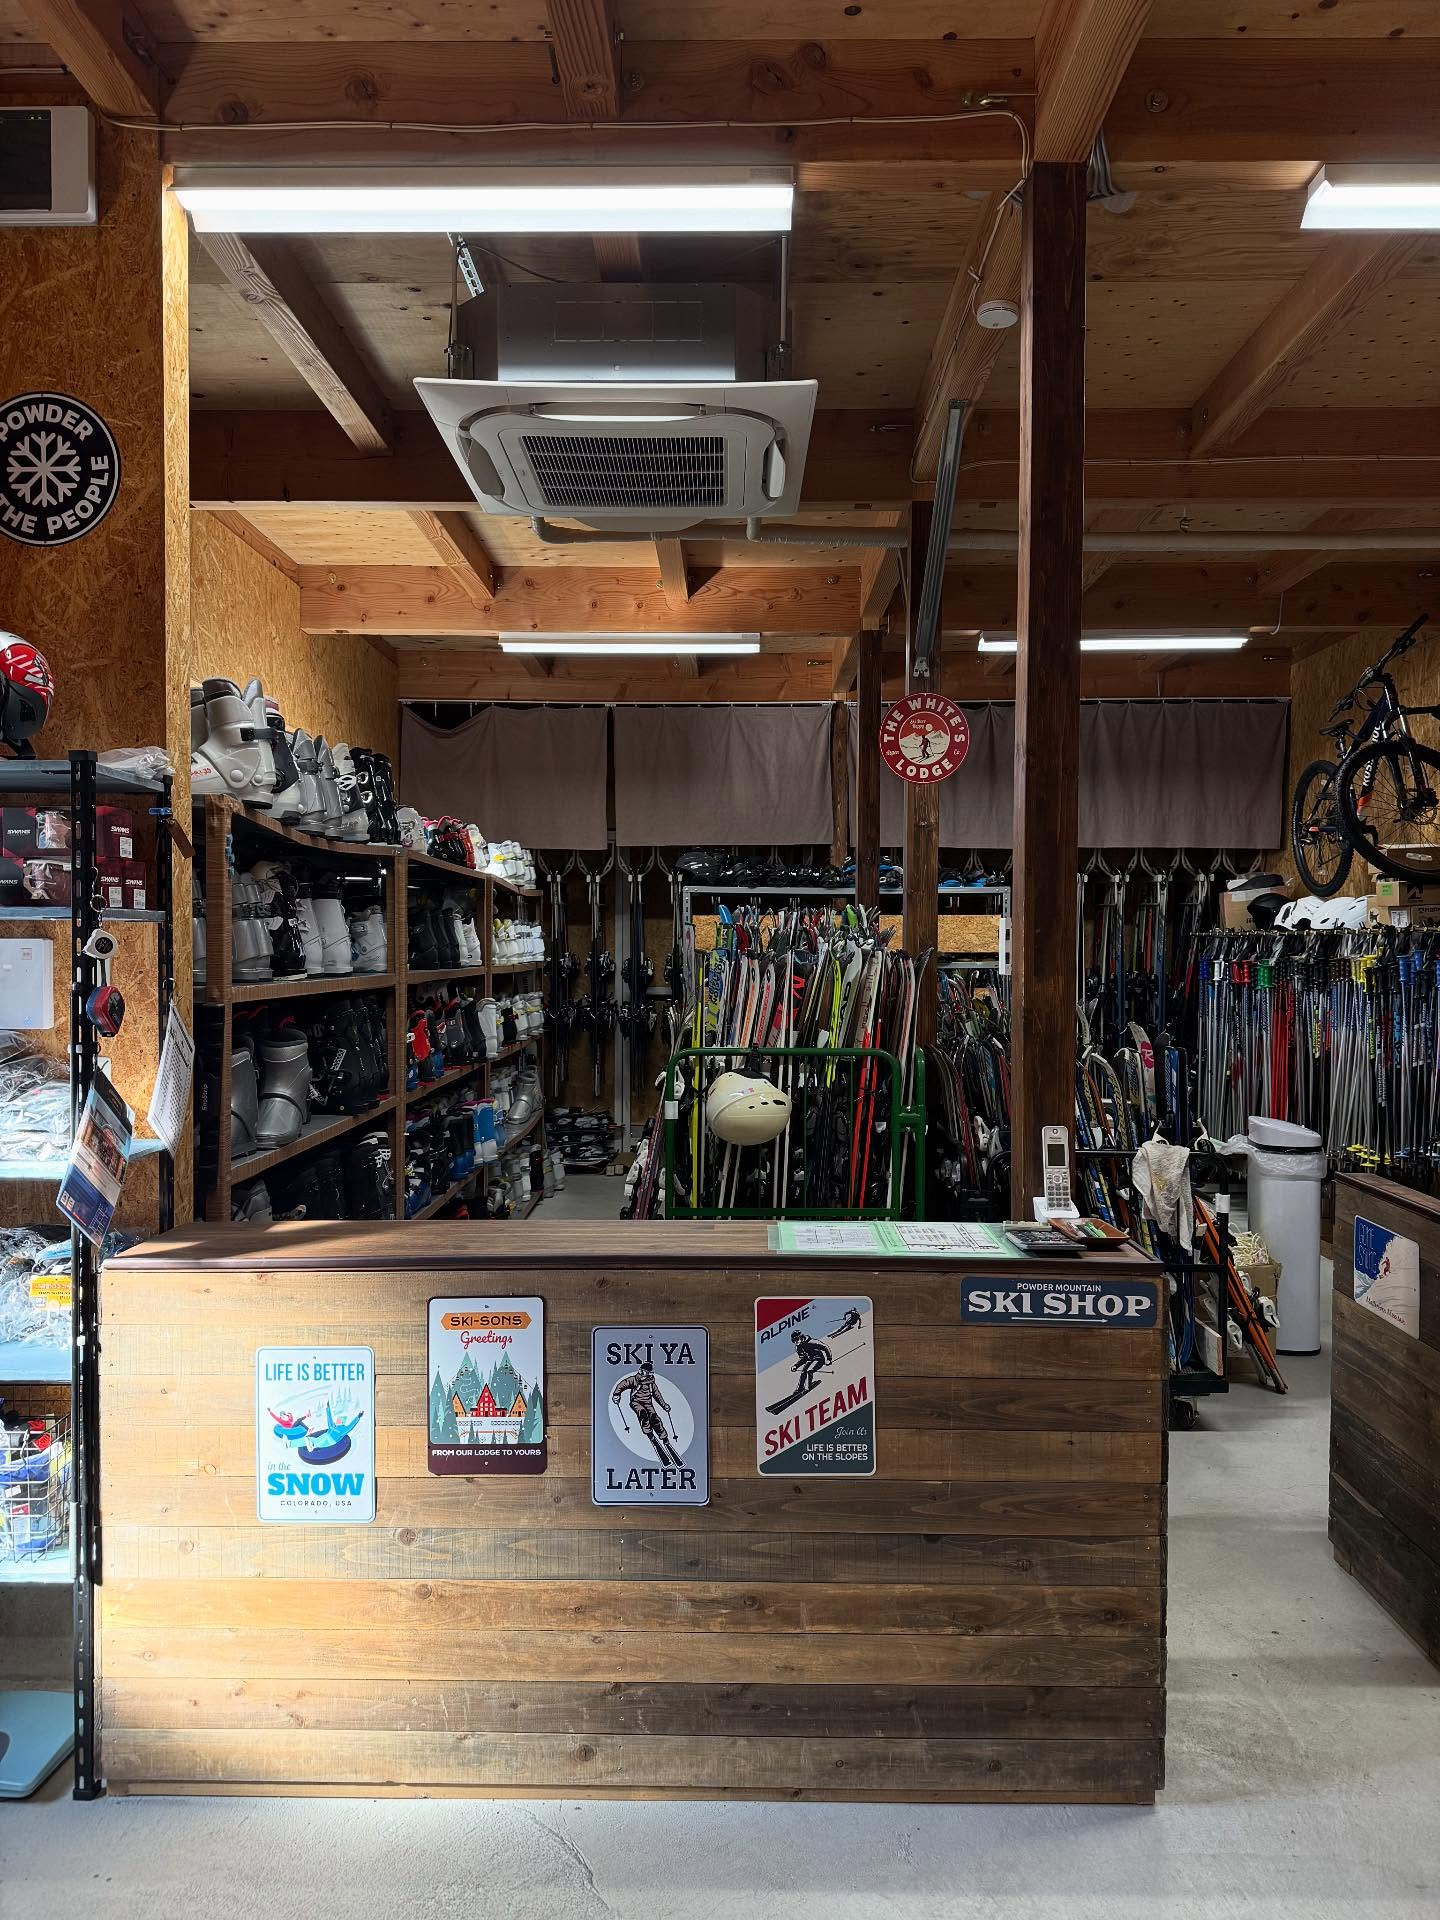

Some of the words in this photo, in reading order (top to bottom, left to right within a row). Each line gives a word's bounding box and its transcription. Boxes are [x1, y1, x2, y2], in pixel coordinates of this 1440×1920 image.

[0, 404, 93, 442] POWDER
[47, 455, 109, 534] PEOPLE
[883, 709, 904, 743] THE
[907, 697, 966, 743] WHITE'S
[895, 758, 953, 779] LODGE
[110, 825, 130, 834] SWANS
[1016, 1282, 1053, 1291] POWDER
[1055, 1283, 1102, 1292] MOUNTAIN
[968, 1290, 1033, 1314] SKI
[1043, 1292, 1151, 1317] SHOP
[450, 1315, 523, 1327] SKI-SONS
[760, 1306, 810, 1345] ALPINE
[460, 1330, 513, 1350] Greetings
[606, 1342, 654, 1365] SKI
[660, 1342, 696, 1365] YA
[265, 1363, 293, 1381] LIFE
[297, 1363, 310, 1381] IS
[313, 1363, 365, 1381] BETTER
[764, 1415, 801, 1457] SKI
[804, 1376, 868, 1432] TEAM
[834, 1426, 854, 1439] Join
[432, 1449, 454, 1457] FROM
[801, 1452, 815, 1461] ON
[816, 1452, 833, 1461] THE
[835, 1452, 868, 1461] SLOPES
[806, 1443, 824, 1452] LIFE
[826, 1443, 834, 1452] IS
[836, 1443, 868, 1452] BETTER
[267, 1462, 276, 1471] in
[278, 1461, 291, 1471] the
[267, 1472, 365, 1496] SNOW
[606, 1467, 697, 1490] LATER
[280, 1500, 332, 1508] COLORADO,
